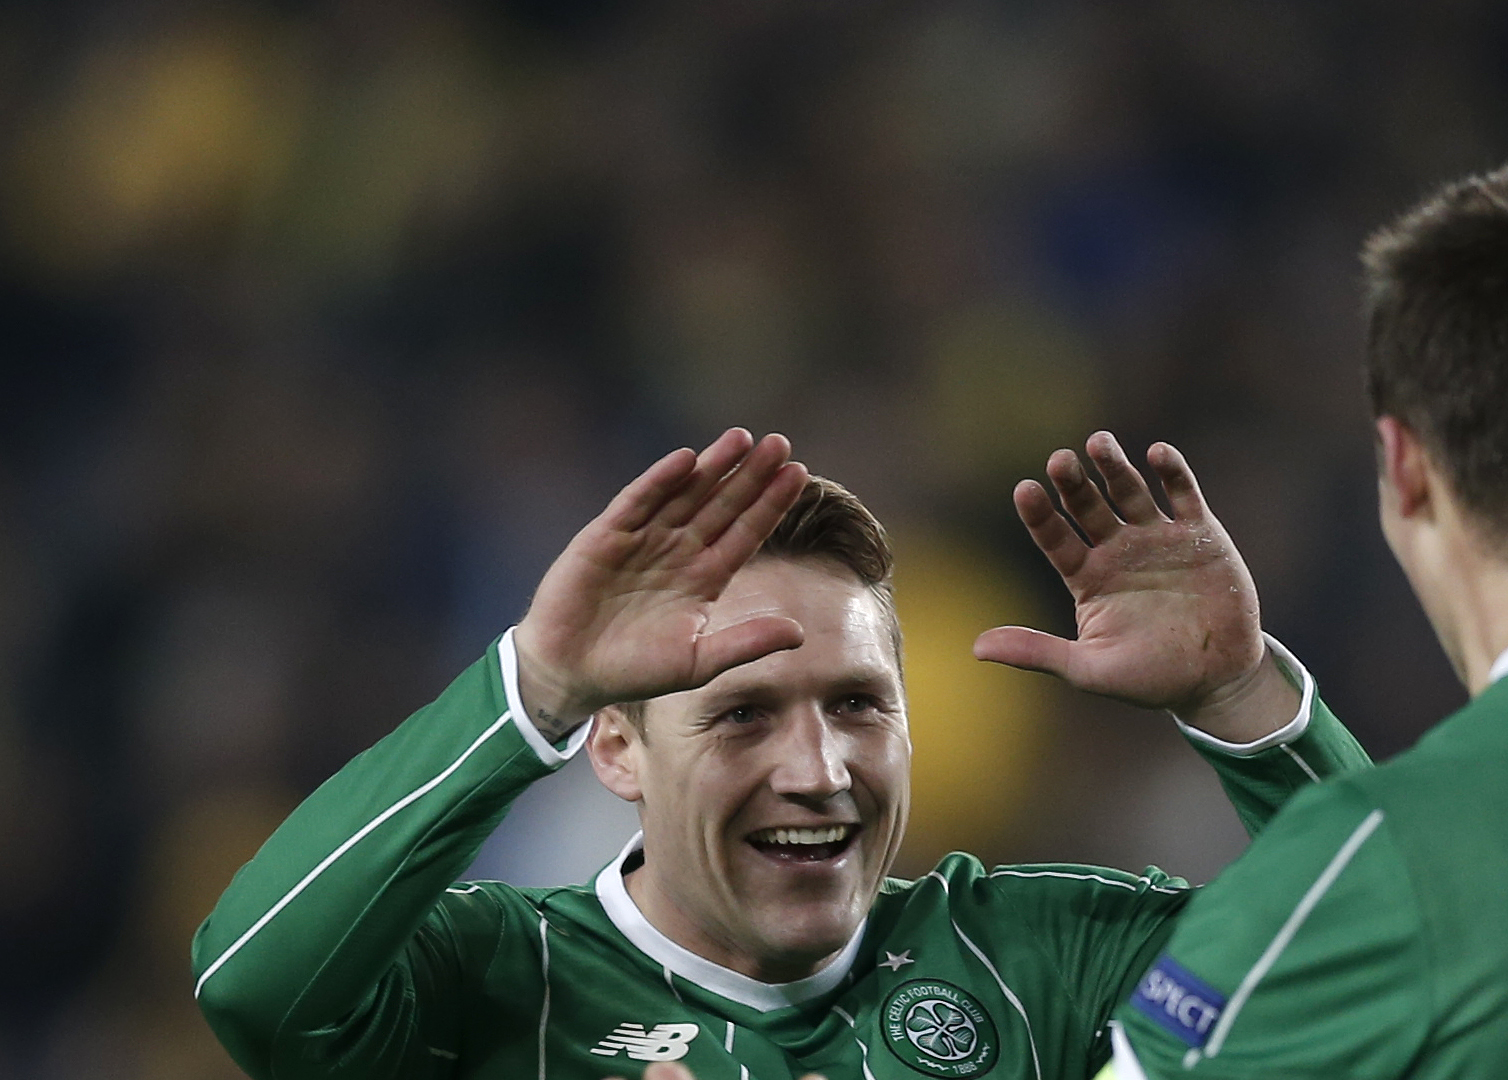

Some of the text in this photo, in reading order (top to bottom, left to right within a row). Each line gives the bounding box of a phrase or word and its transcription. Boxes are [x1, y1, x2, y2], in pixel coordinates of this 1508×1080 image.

[888, 986, 985, 1042] THE CELTIC FOOTBALL CLUB
[1140, 968, 1220, 1034] SPECT
